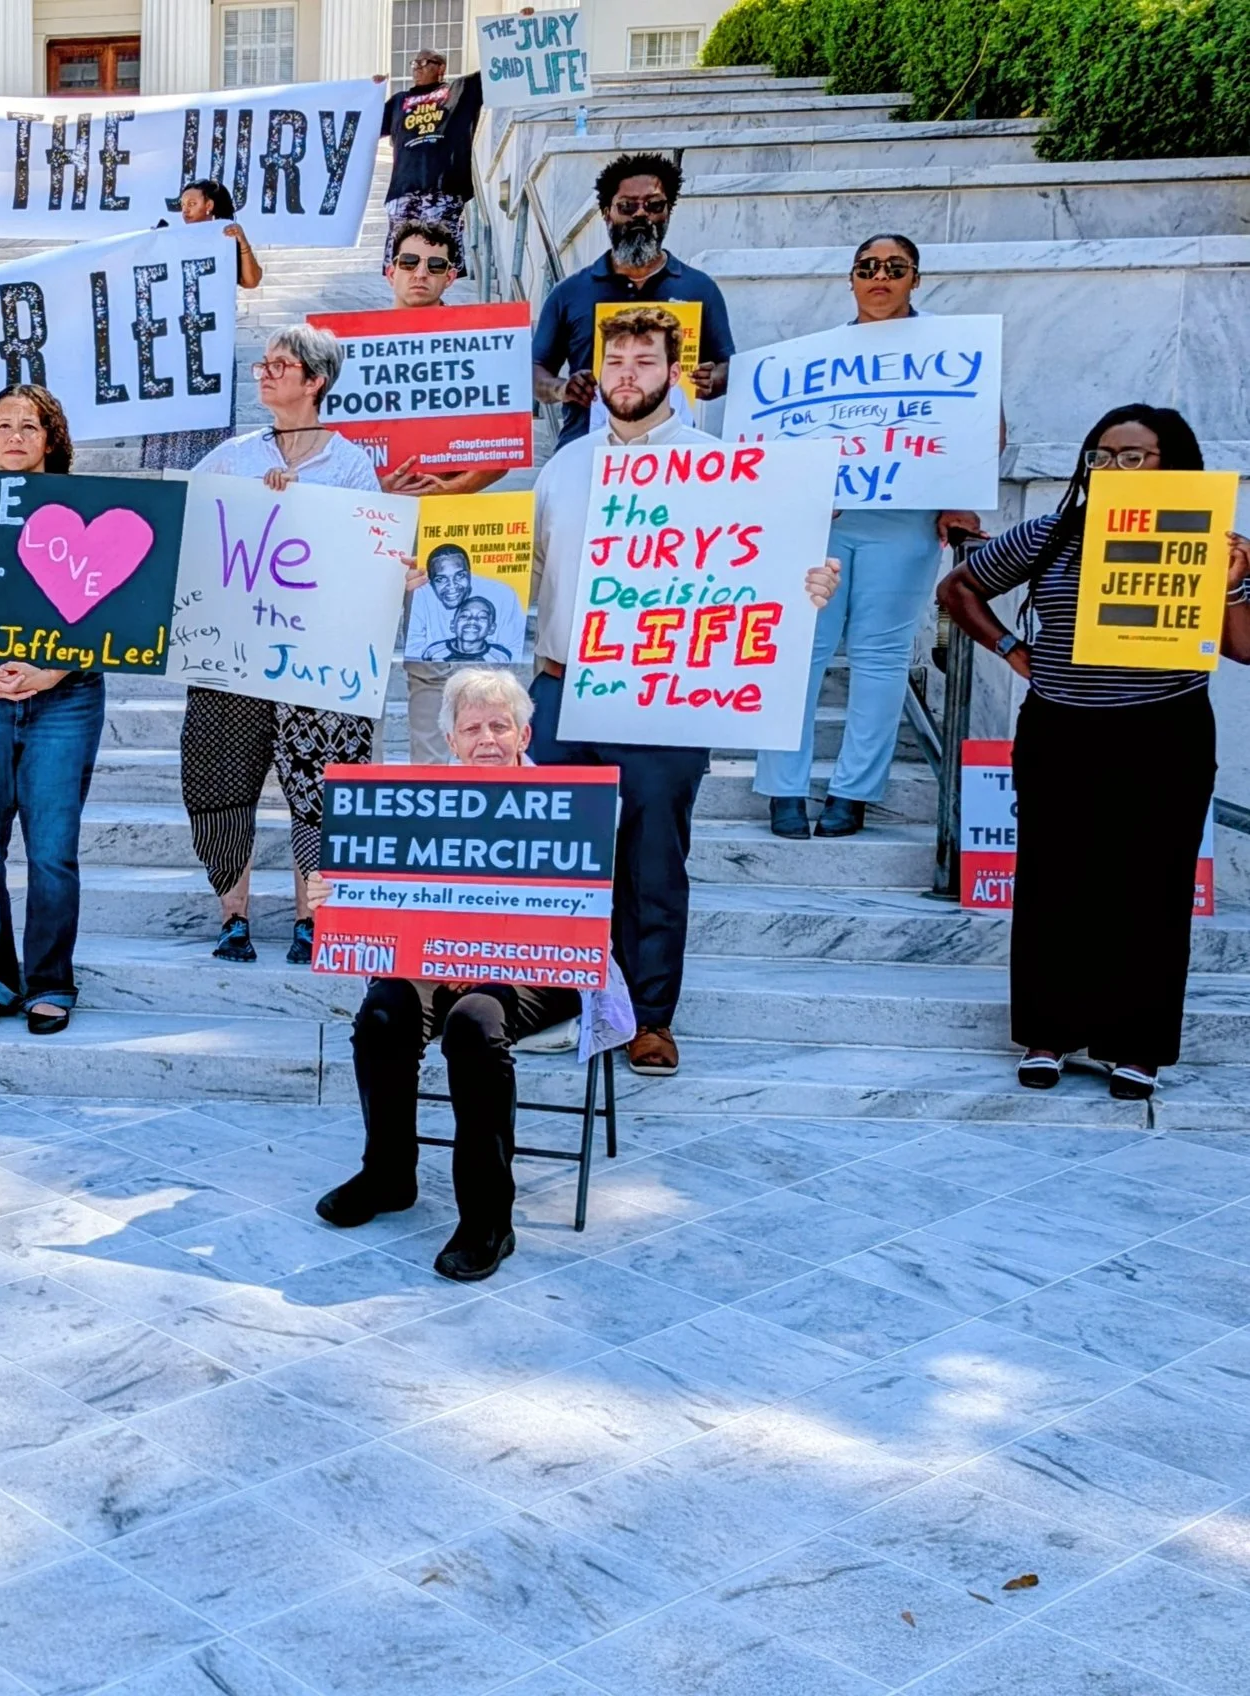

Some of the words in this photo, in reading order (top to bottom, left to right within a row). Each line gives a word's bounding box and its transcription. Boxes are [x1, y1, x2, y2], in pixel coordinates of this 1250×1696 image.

[482, 18, 516, 41] THE
[515, 13, 579, 50] JURY
[488, 56, 525, 82] SAID
[526, 49, 587, 96] LIFE!
[404, 110, 444, 130] CROW
[413, 102, 437, 115] JIM
[418, 123, 435, 135] 2.0
[6, 109, 136, 211] THE
[164, 108, 362, 216] JURY
[90, 257, 221, 405] LEE
[362, 340, 424, 358] DEATH
[431, 334, 515, 354] PENALTY
[359, 360, 475, 386] TARGETS
[753, 350, 983, 406] CLEMENCY
[327, 389, 402, 415] POOR
[411, 384, 510, 411] PEOPLE
[780, 410, 817, 429] FOR
[829, 403, 888, 424] JEFFERY
[897, 400, 933, 418] LEE
[420, 449, 525, 464] DeathPenaltyAction.org
[449, 437, 524, 449] #StopExecutions
[881, 427, 947, 457] THE
[601, 447, 765, 486] HONOR
[834, 462, 901, 502] RY!
[601, 494, 669, 527] the
[1107, 509, 1151, 532] LIFE
[424, 526, 441, 538] THE
[444, 525, 469, 537] JURY
[473, 523, 503, 536] VOTED
[507, 522, 530, 535] LIFE.
[216, 499, 319, 592] We
[373, 541, 406, 558] Lee
[470, 543, 506, 552] ALABAMA
[507, 541, 530, 551] PLANS
[472, 555, 481, 563] TO
[483, 554, 513, 563] EXECUTE
[515, 553, 530, 561] HIM
[589, 523, 764, 569] JURY'S
[1165, 541, 1208, 565] FOR
[25, 525, 103, 597] LOVE
[589, 574, 757, 609] Decision
[1101, 572, 1202, 598] JEFFERY
[172, 590, 203, 616] ave
[253, 598, 306, 631] the
[1163, 605, 1202, 629] LEE
[102, 626, 166, 666] Lee!
[169, 625, 221, 647] effrey
[578, 602, 784, 667] LIFE
[263, 644, 379, 702] Jury!
[574, 668, 627, 699] for
[333, 788, 487, 819] BLESSED
[494, 790, 572, 820] ARE
[328, 835, 398, 865] THE
[406, 837, 601, 872] MERCIFUL
[370, 886, 408, 908] they
[412, 888, 452, 905] shall
[458, 891, 519, 907] receive
[354, 936, 396, 944] PENALTY
[422, 938, 603, 964] #STOPEXECUTIONS
[314, 943, 395, 973] ACTION
[422, 962, 601, 986] DEATHPENALTY.ORG
